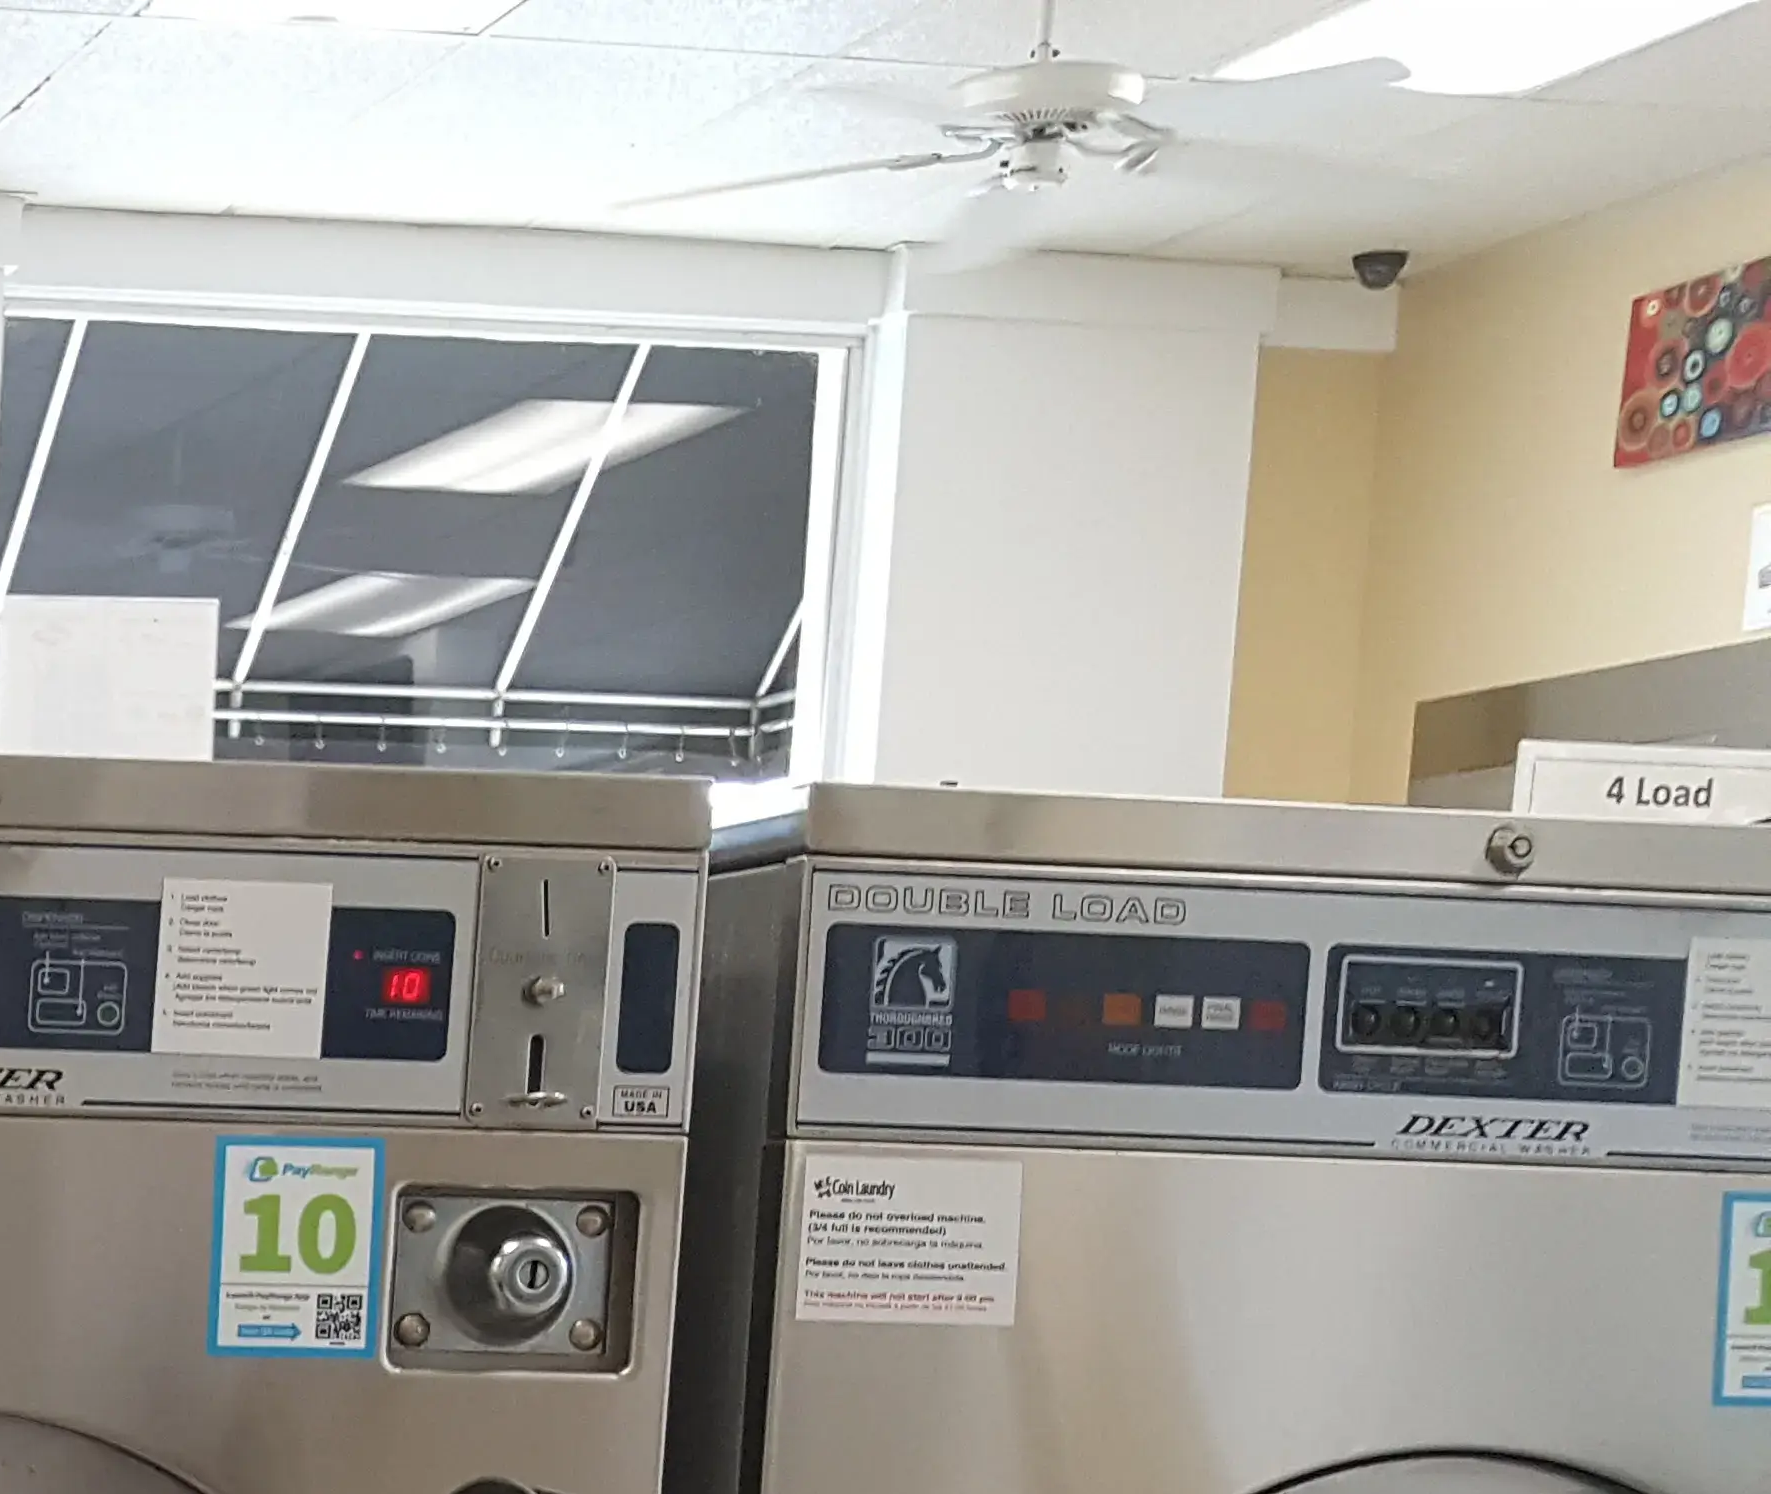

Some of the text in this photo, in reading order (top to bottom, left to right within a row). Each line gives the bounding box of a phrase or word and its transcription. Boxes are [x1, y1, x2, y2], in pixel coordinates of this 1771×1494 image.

[1606, 776, 1713, 807] 4 Load
[828, 884, 1187, 926] DOUBLE LOAD
[388, 971, 422, 1000] 10
[620, 1089, 662, 1099] MADE IN
[624, 1099, 658, 1115] USA
[1395, 1114, 1591, 1143] DEXTER
[1391, 1138, 1507, 1154] COMMERCIAL
[832, 1179, 895, 1200] Coin Laundry
[239, 1194, 357, 1274] 10
